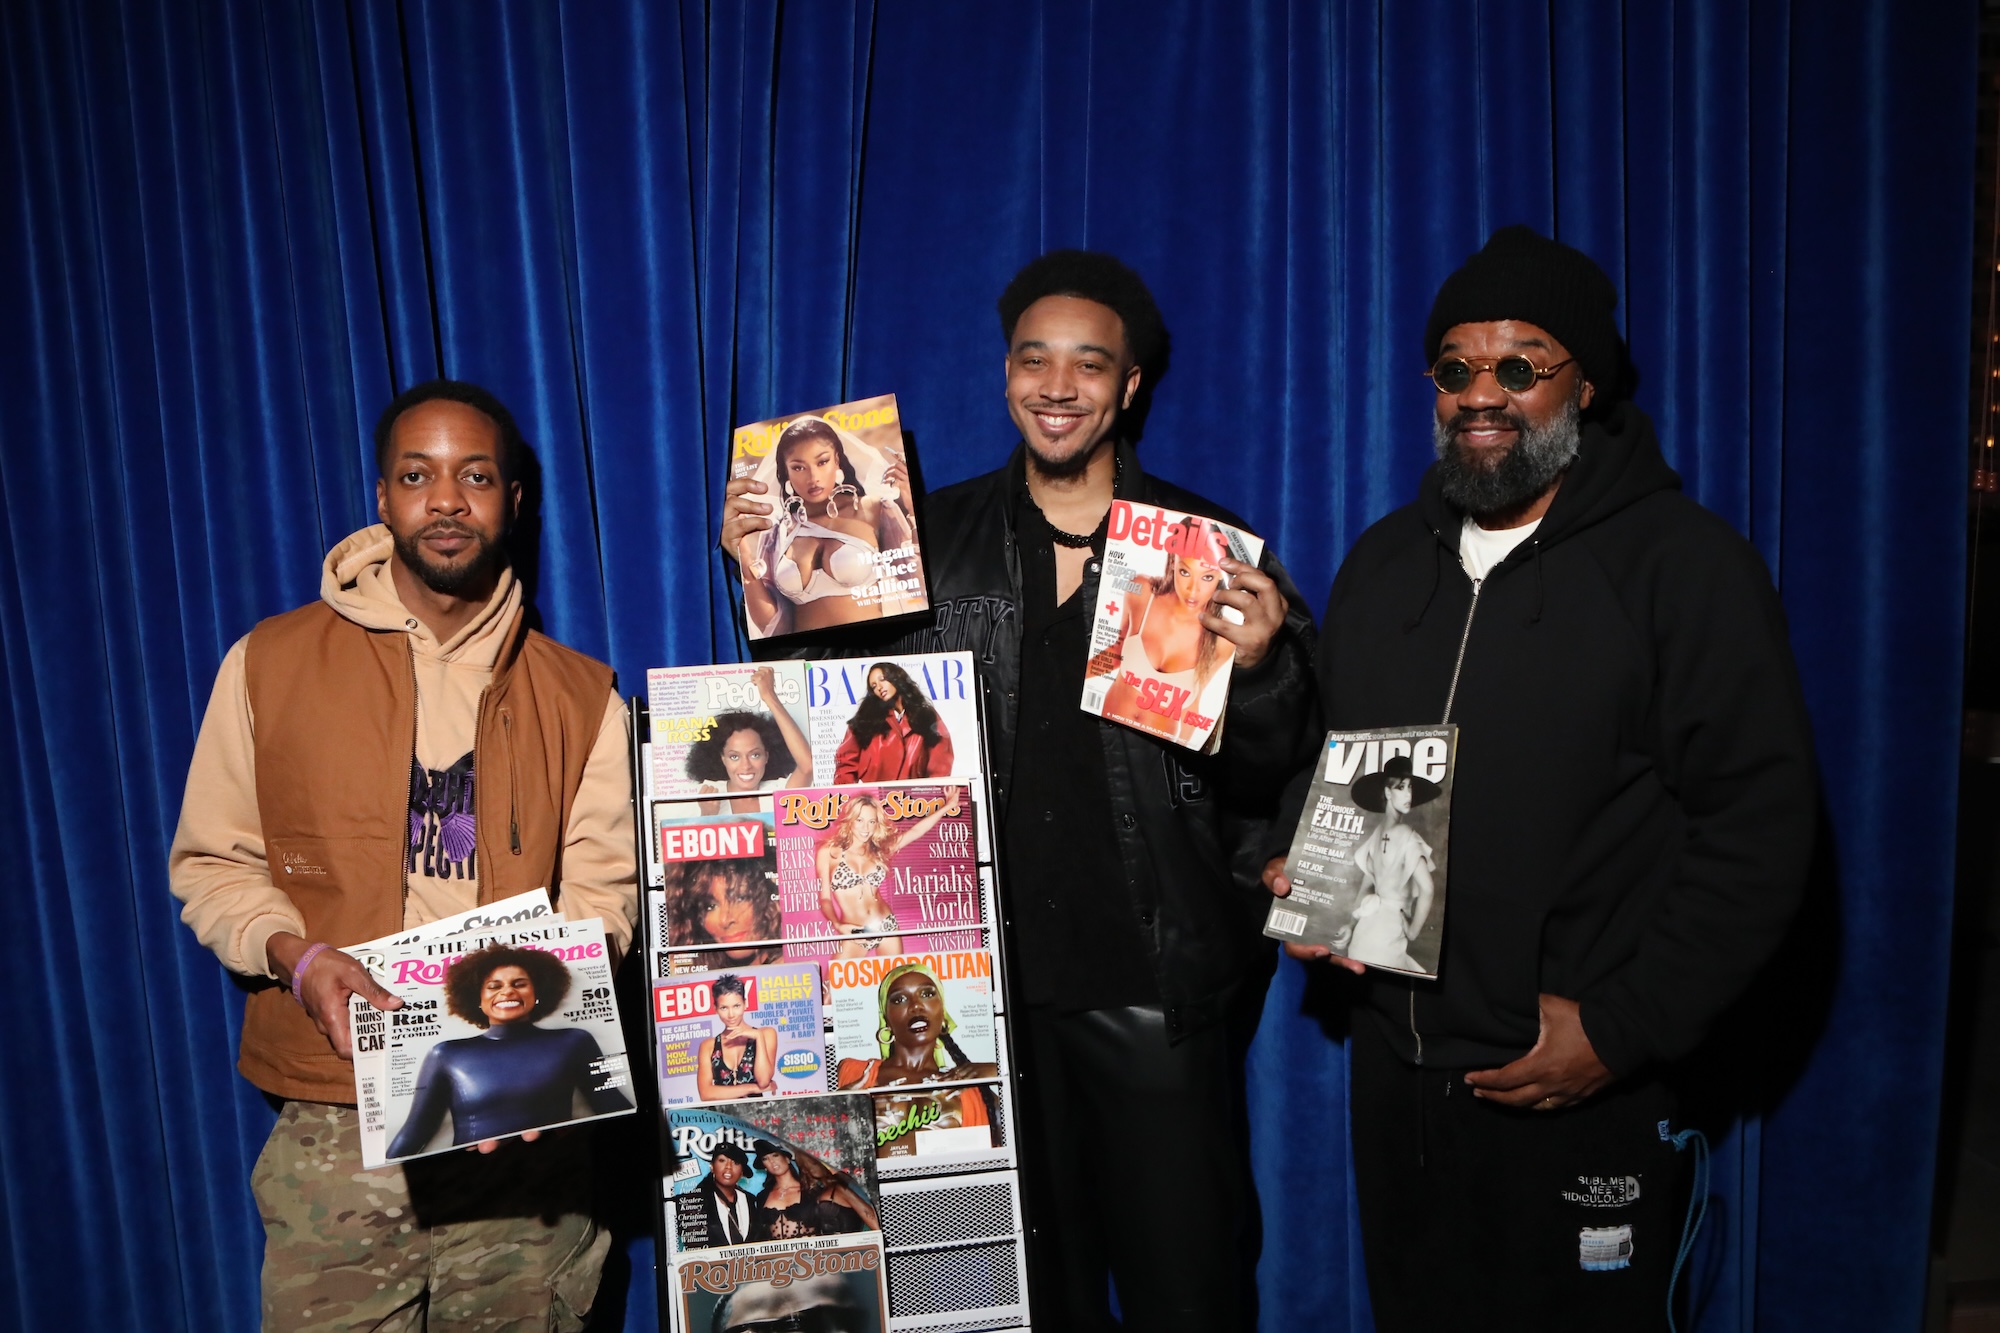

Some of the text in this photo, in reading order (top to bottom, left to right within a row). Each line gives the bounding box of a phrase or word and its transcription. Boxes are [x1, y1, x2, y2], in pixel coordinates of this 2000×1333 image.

[1107, 500, 1229, 563] Details
[857, 546, 915, 567] Megan
[1108, 550, 1125, 560] HOW
[872, 562, 918, 579] Thee
[850, 577, 920, 600] Stallion
[1112, 577, 1143, 596] MODEL
[856, 599, 871, 607] Will
[705, 672, 800, 712] Peole
[1123, 670, 1191, 722] The SEX
[656, 716, 719, 732] DIANA
[1111, 713, 1125, 723] HOW
[1183, 710, 1214, 731] ISSUE
[667, 728, 711, 743] ROSS
[1331, 733, 1344, 742] RAP
[1344, 733, 1356, 742] MUG
[1356, 732, 1372, 741] SHOTS:
[1386, 732, 1401, 740] Eminem,
[1417, 730, 1425, 738] Kim
[1425, 730, 1433, 738] Say
[1433, 729, 1449, 737] Cheese
[1319, 794, 1334, 805] THE
[1316, 801, 1356, 815] NOTORIOUS
[1311, 808, 1365, 835] F.A.I.T.H.
[1307, 831, 1334, 843] Life After
[1310, 825, 1329, 836] Tupac,
[1348, 833, 1360, 841] and
[665, 824, 760, 859] EBONY
[779, 836, 815, 852] BEHIND
[929, 842, 970, 859] SMACK
[1303, 842, 1329, 855] BEENIE
[1327, 848, 1346, 859] MAN
[780, 850, 815, 870] BARS
[1297, 859, 1325, 873] FAT JOE
[781, 868, 808, 881] WITH A
[893, 865, 973, 895] Mariah's
[781, 878, 823, 894] TEENAGE
[917, 893, 975, 922] World
[785, 920, 835, 940] ROCK &
[423, 940, 468, 956] THE
[475, 935, 503, 950] TV
[511, 927, 570, 945] ISSUE
[928, 934, 976, 952] NONSTOP
[787, 940, 843, 958] WRESTLING
[674, 964, 709, 974] NEW CARS
[761, 973, 812, 989] HALLE
[582, 987, 610, 1001] 50
[659, 979, 754, 1019] EBOY
[758, 985, 813, 1003] BERRY
[354, 1001, 373, 1012] THE
[583, 999, 611, 1008] BEST
[764, 999, 814, 1011] ON HER PUBLIC
[563, 1006, 613, 1018] SITCOMS
[751, 1008, 814, 1019] TROUBLES, PRIVATE
[393, 1013, 438, 1026] Rae
[760, 1015, 815, 1027] JOYS SUDDEN
[412, 1024, 442, 1032] QUEEN
[661, 1023, 701, 1035] THE CASE FOR
[778, 1022, 815, 1032] DESIRE FOR
[661, 1029, 711, 1043] REPARATIONS
[791, 1030, 816, 1039] A BABY
[665, 1041, 691, 1051] WHY?
[666, 1051, 688, 1060] HOW
[667, 1055, 698, 1067] MUCH?
[667, 1064, 699, 1075] WHEN?
[781, 1064, 818, 1074] UNCENSORED
[668, 1095, 694, 1105] How To
[365, 1110, 383, 1118] CHARLI
[670, 1111, 717, 1127] Quentin
[877, 1101, 940, 1147] oechii
[675, 1167, 698, 1178] ISSUE
[1577, 1175, 1625, 1186] SUBLME
[679, 1197, 704, 1205] Sleater-
[680, 1203, 704, 1211] Kinney
[677, 1212, 708, 1221] Christina
[679, 1219, 708, 1229] Aguilera
[681, 1228, 708, 1237] Lucinda
[681, 1235, 709, 1243] Williams
[719, 1248, 756, 1259] YUNGBLUD
[760, 1243, 789, 1254] CHARLIE
[789, 1241, 810, 1251] PUTH
[814, 1239, 840, 1248] JAYDEE
[790, 1247, 881, 1280] Stone
